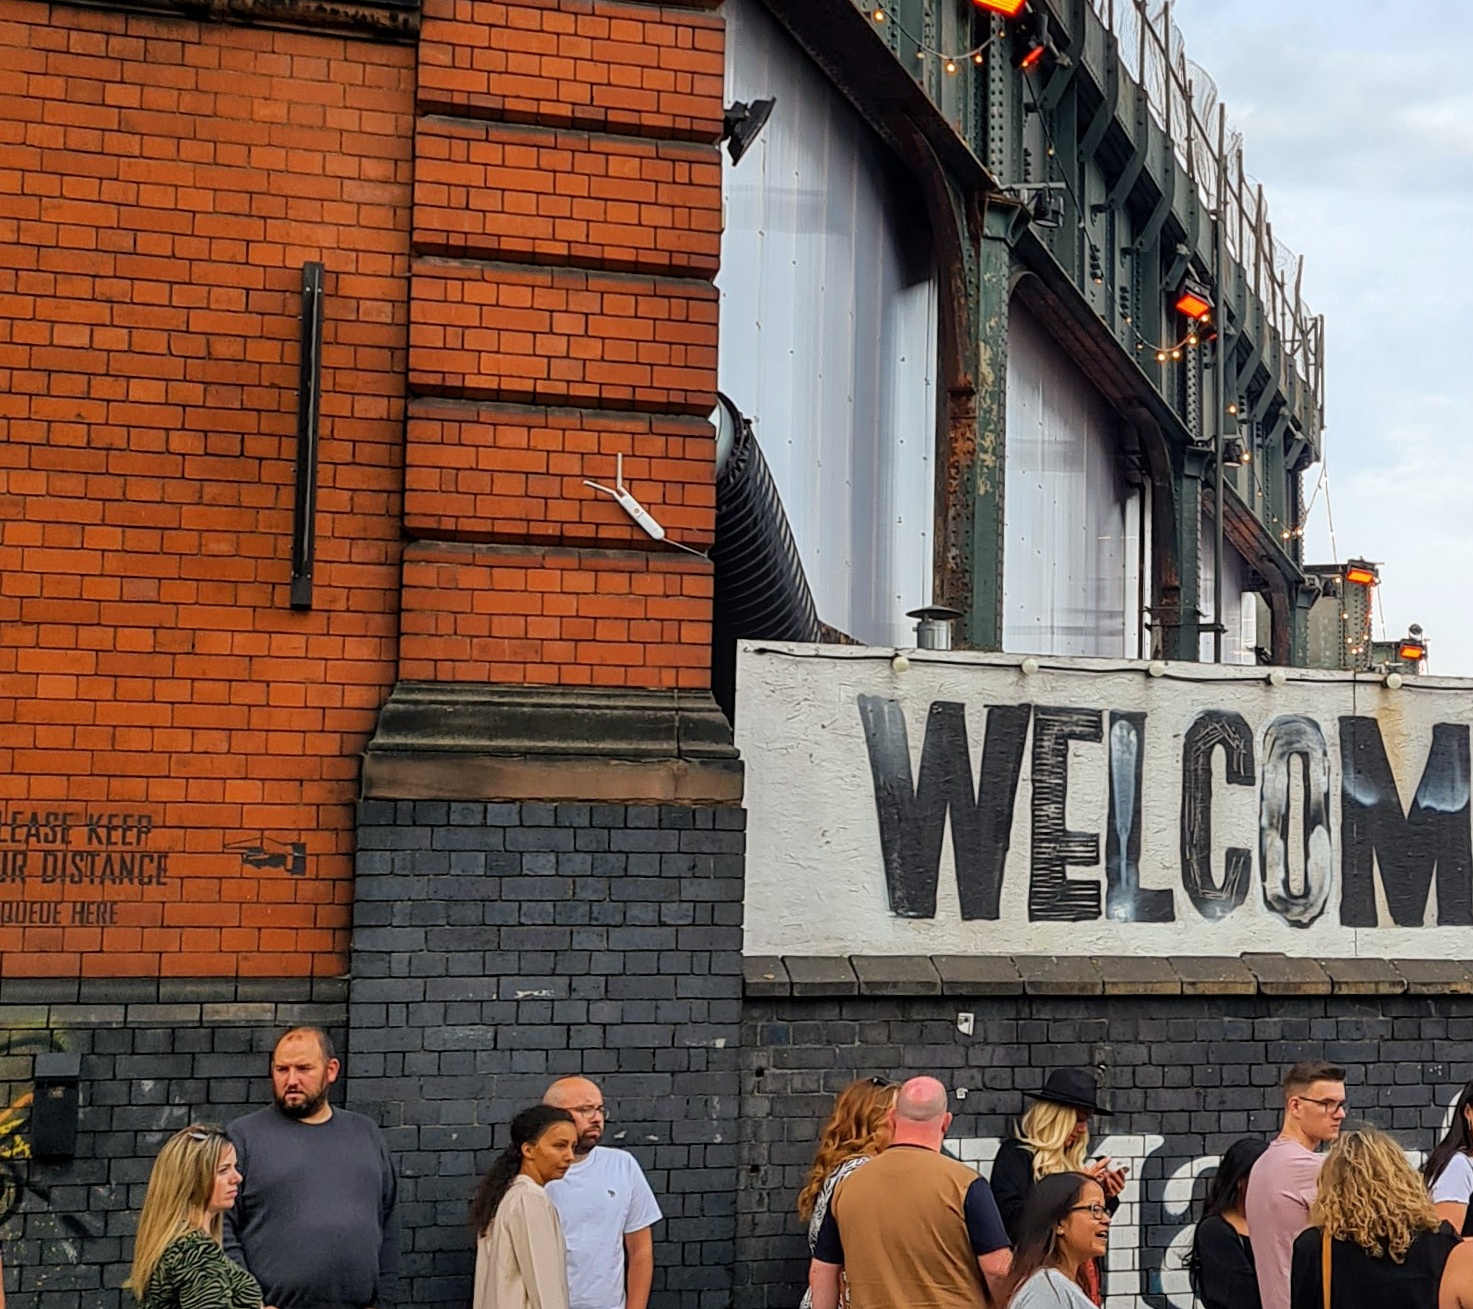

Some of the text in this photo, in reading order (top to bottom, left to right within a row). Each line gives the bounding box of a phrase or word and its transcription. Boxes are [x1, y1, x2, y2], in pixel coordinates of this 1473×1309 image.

[87, 812, 153, 846] KEEP
[41, 851, 169, 886] DISTANCE
[1, 901, 118, 925] QUEUE HERE
